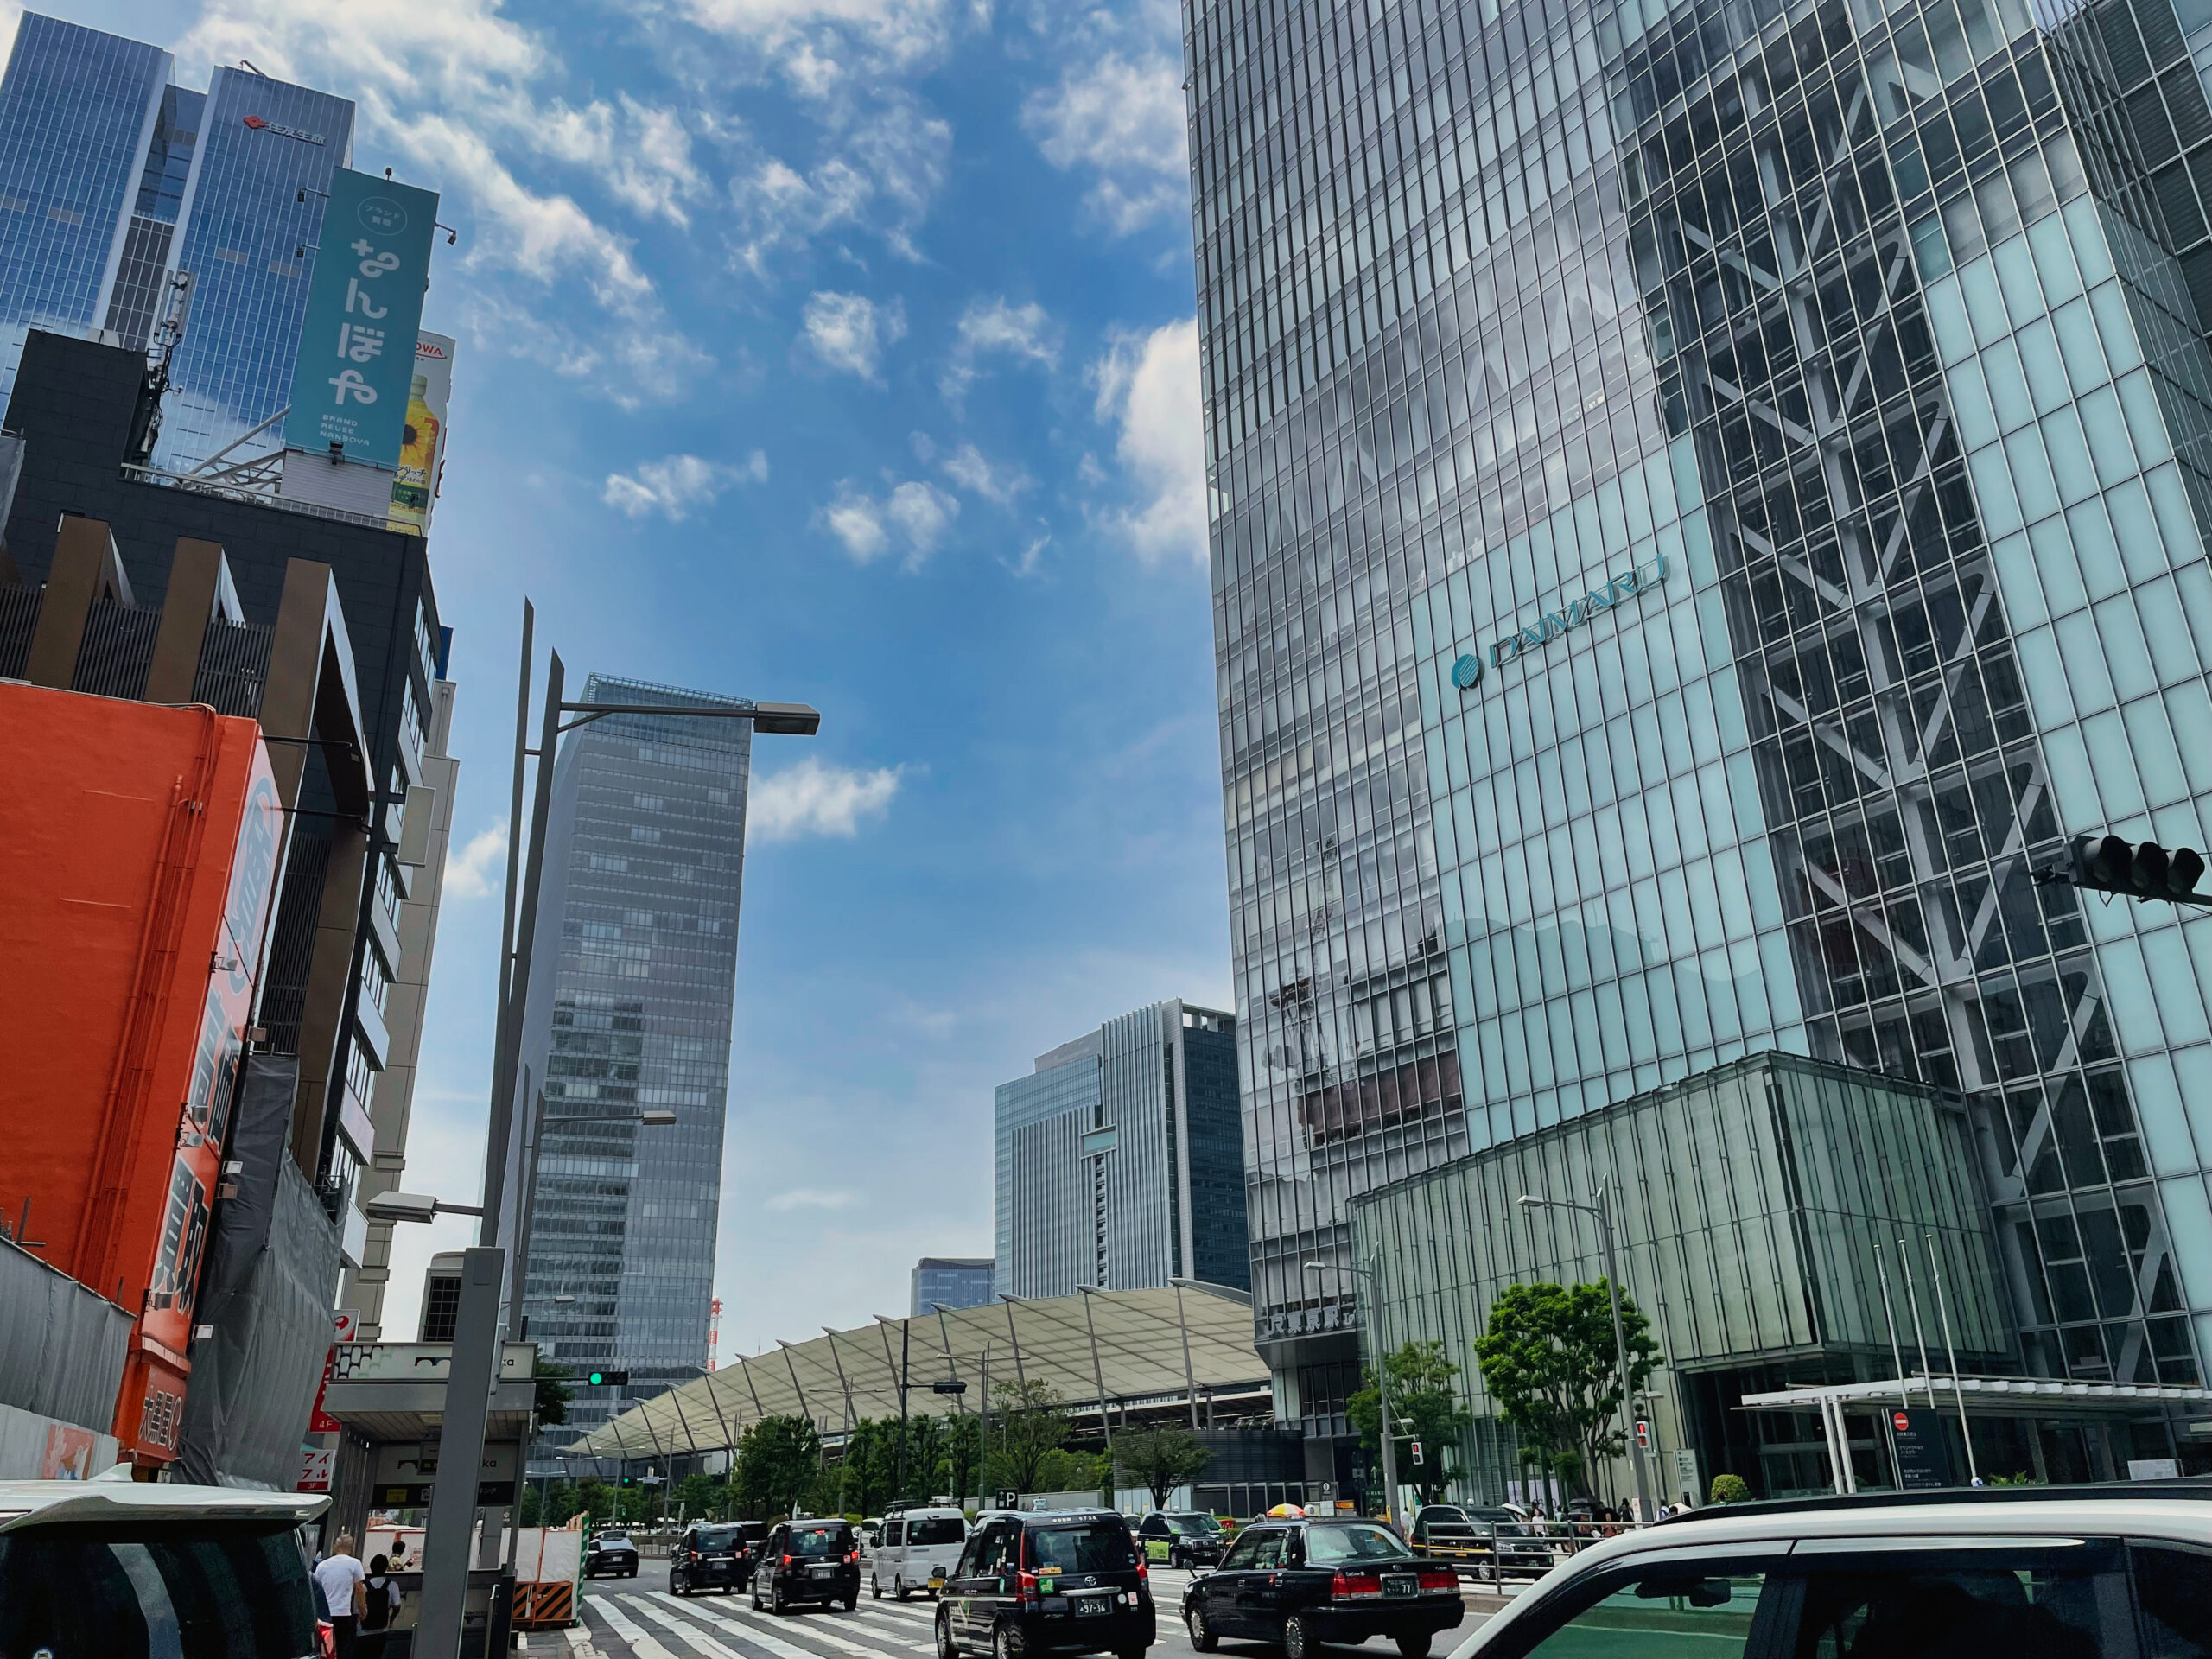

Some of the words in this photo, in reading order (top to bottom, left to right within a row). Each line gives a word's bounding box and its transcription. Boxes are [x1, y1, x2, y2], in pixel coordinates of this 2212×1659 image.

[266, 122, 326, 144] 住友生命
[327, 238, 401, 405] なんぼや
[416, 341, 442, 356] OWA
[321, 422, 354, 435] REUSE
[322, 414, 358, 427] BRAND
[319, 430, 370, 446] NANBOYA
[1489, 553, 1664, 669] DAIMARU
[319, 1419, 333, 1428] 4F
[1006, 1492, 1016, 1508] P
